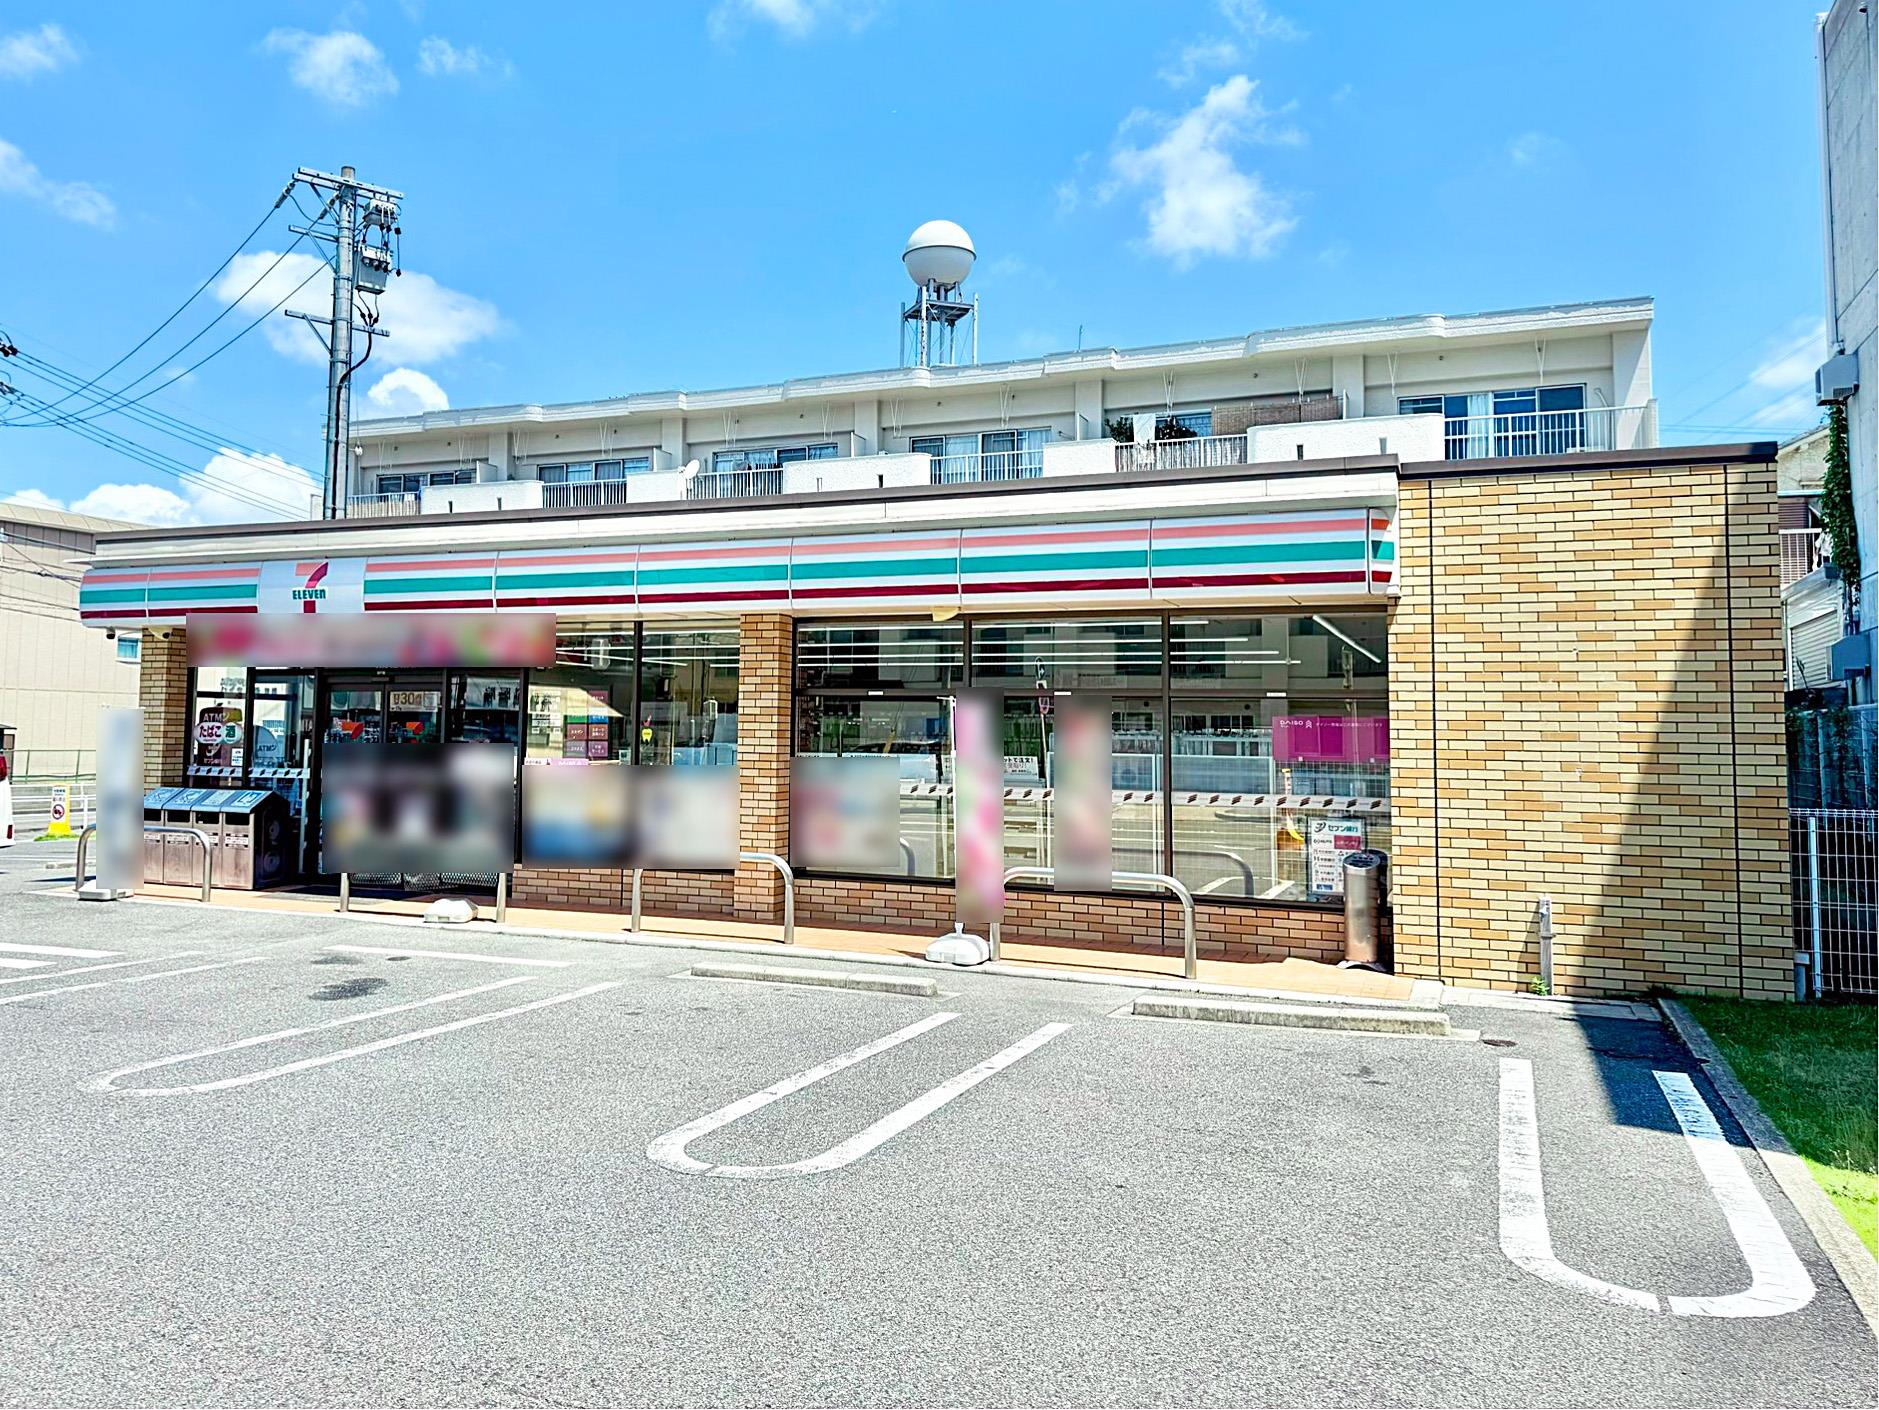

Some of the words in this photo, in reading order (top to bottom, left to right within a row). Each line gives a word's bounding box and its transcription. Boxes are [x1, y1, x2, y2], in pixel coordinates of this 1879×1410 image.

[294, 561, 329, 613] 7
[203, 713, 223, 721] ATM
[199, 724, 222, 738] たばこ
[225, 725, 236, 739] 酒
